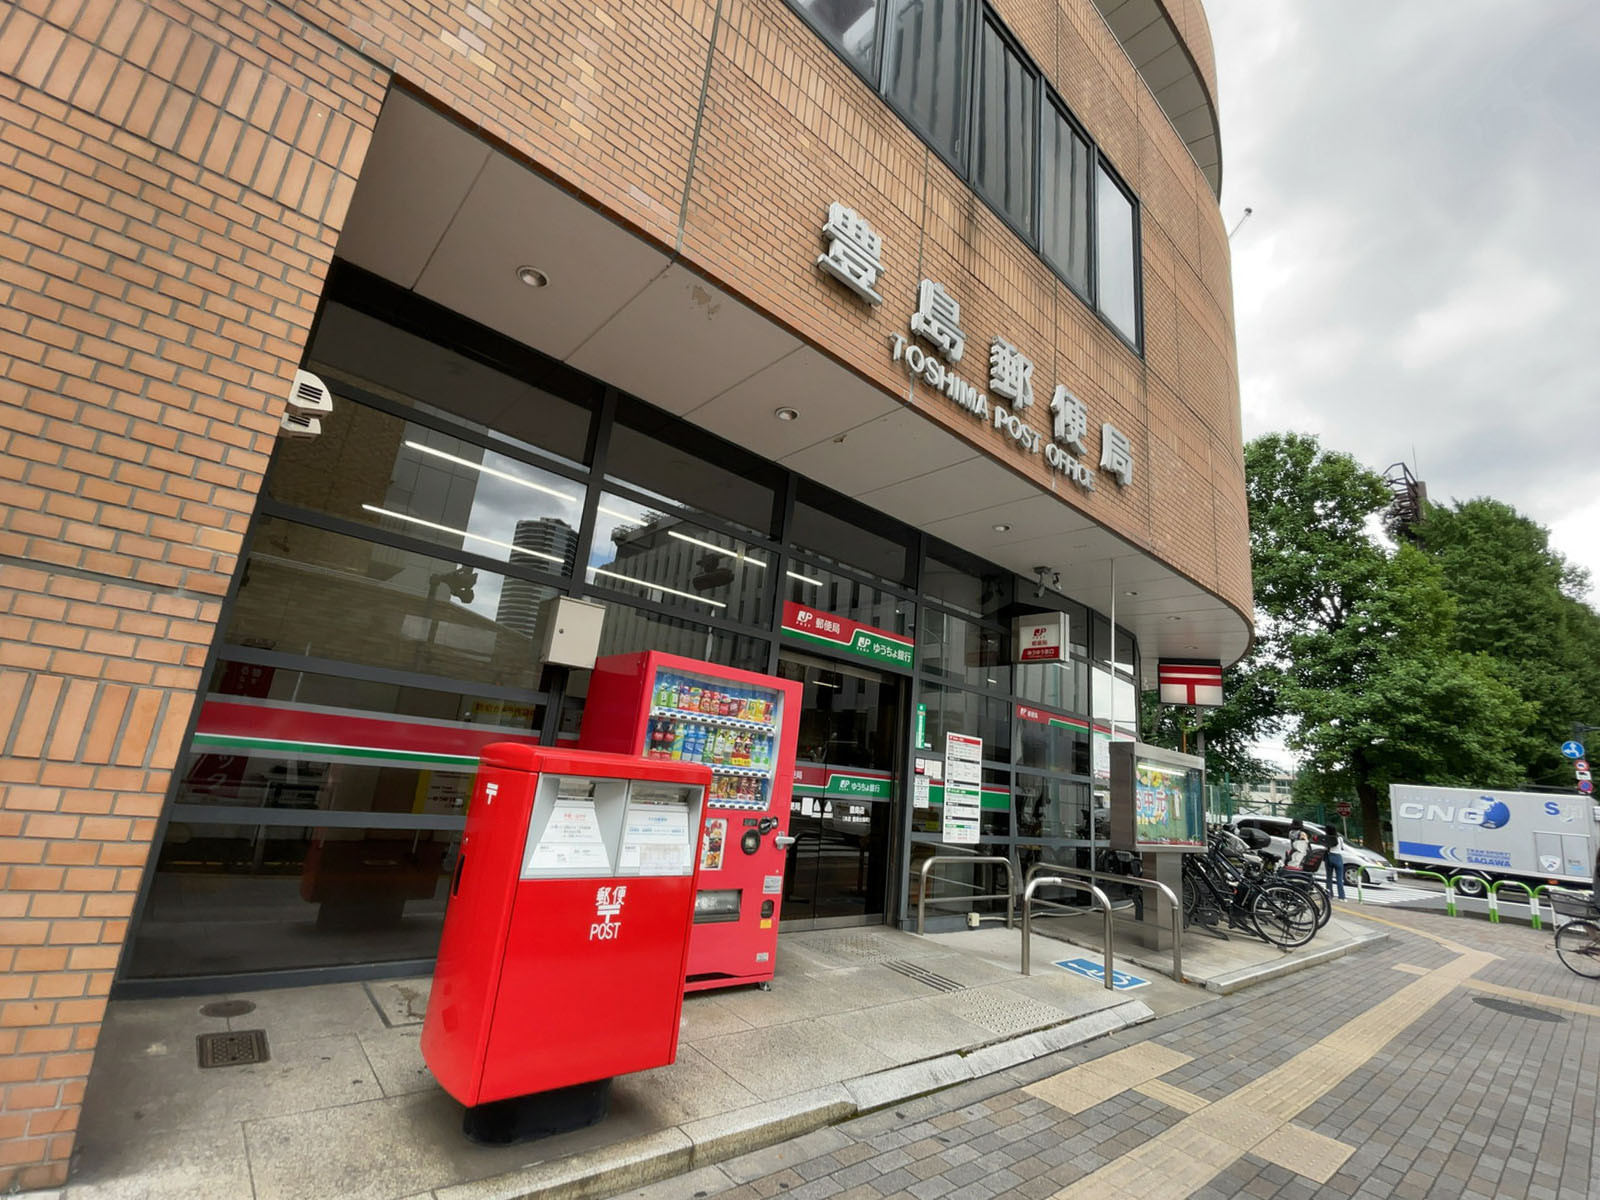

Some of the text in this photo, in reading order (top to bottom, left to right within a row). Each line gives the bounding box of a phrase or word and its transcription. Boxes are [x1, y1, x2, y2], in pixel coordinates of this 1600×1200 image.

[817, 201, 1133, 488] 豊島郵便局
[888, 332, 1095, 493] TOSHIMA POST OFFICE
[873, 643, 912, 663] ゆうちょ銀行
[851, 783, 880, 793] ゆうちょ銀行
[1399, 802, 1486, 825] CNG
[1467, 856, 1512, 868] SAGAWA
[595, 886, 627, 907] 郵便
[589, 922, 621, 940] POST
